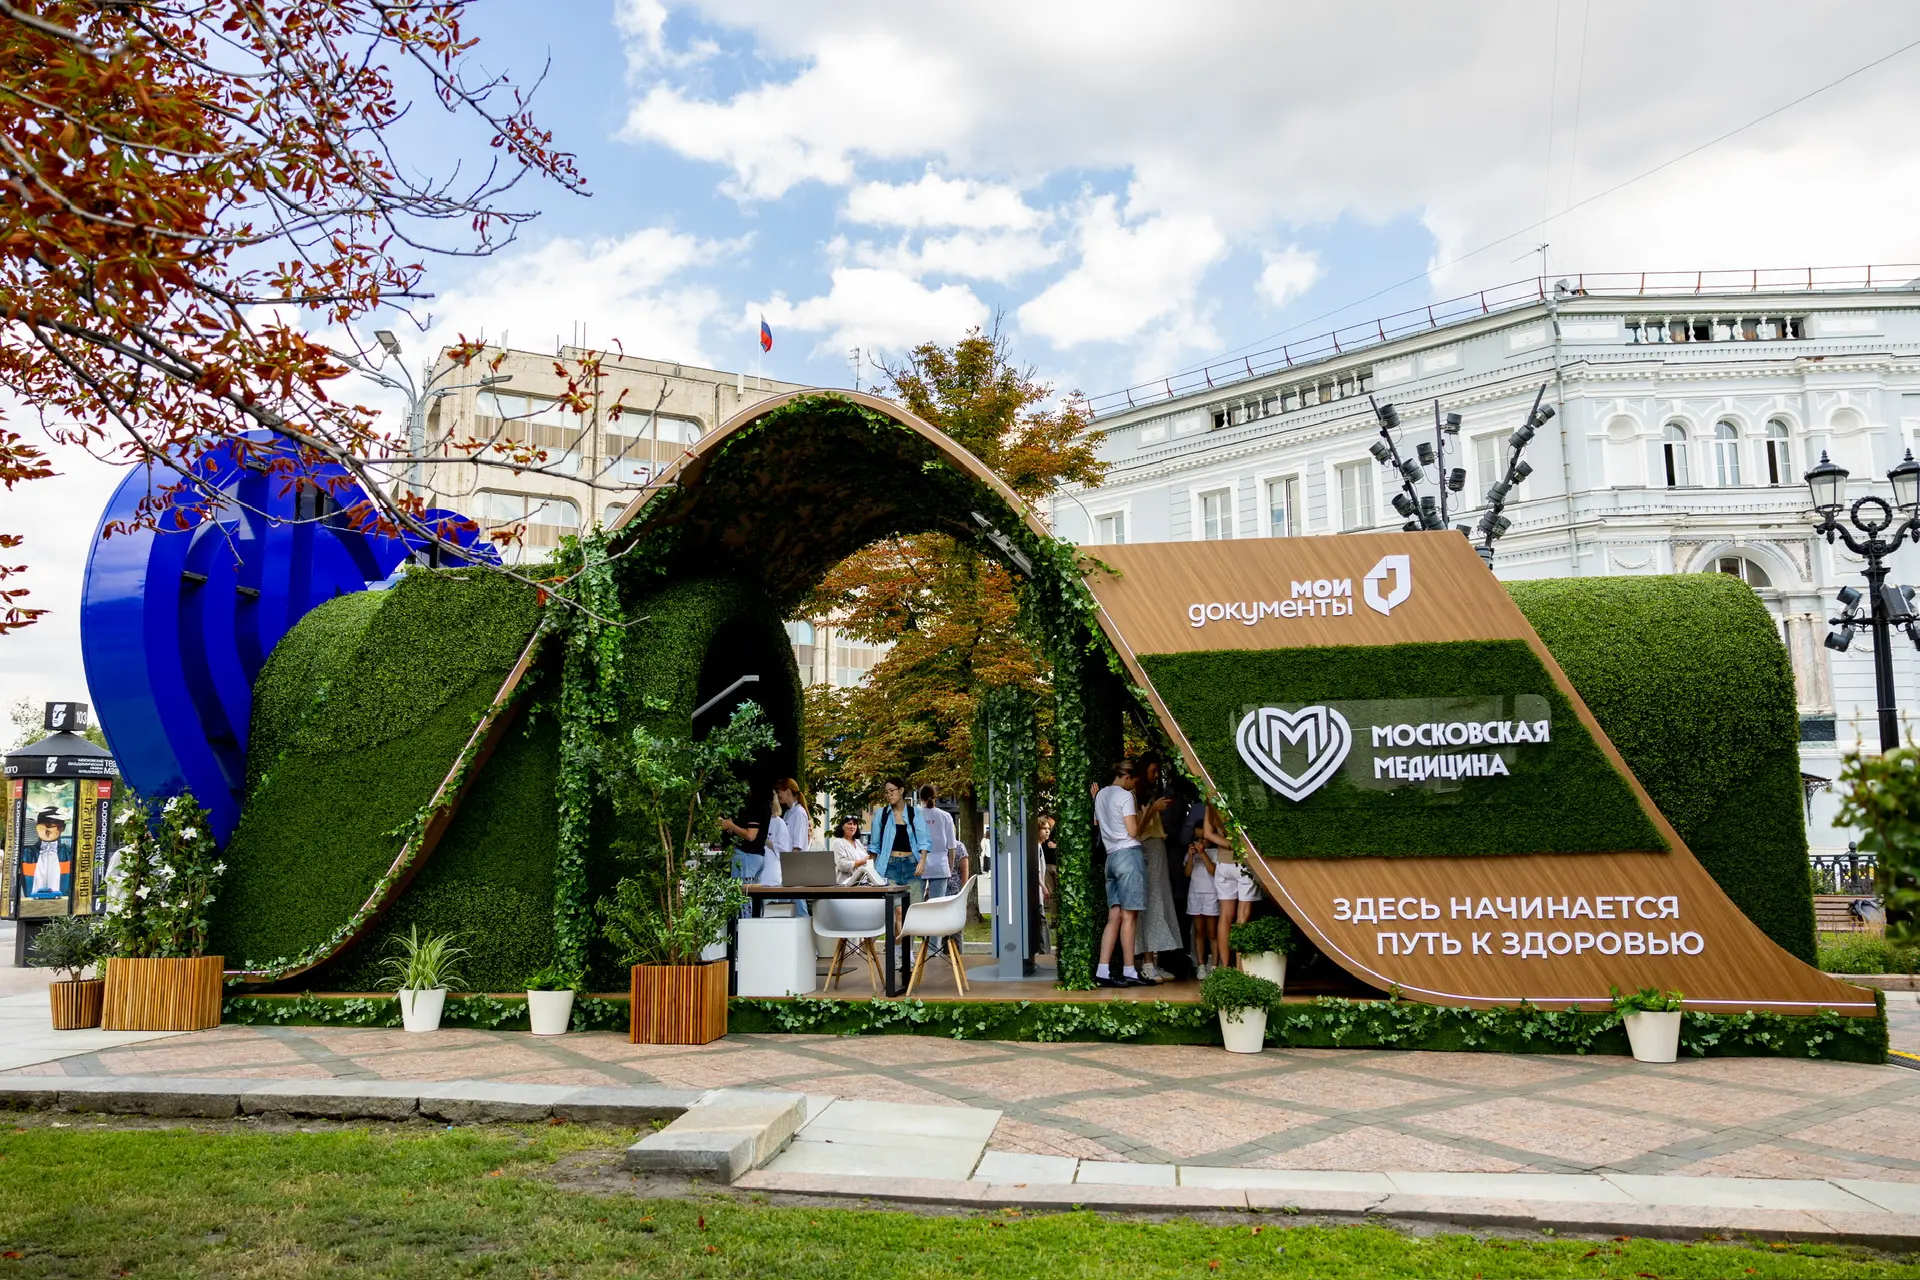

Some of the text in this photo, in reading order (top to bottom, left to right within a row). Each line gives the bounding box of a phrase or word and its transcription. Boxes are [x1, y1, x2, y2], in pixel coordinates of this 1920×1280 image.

[1188, 597, 1354, 628] документы
[76, 711, 87, 724] 103
[1371, 719, 1551, 748] МОСКОВСКАЯ
[1373, 753, 1510, 782] МЕДИЦИНА
[81, 845, 92, 873] МОЕГО
[1332, 895, 1680, 925] ЗДЕСЬ НАЧИНАЕТСЯ
[1376, 931, 1705, 959] ПУТЬ К ЗДОРОВЬЮ
